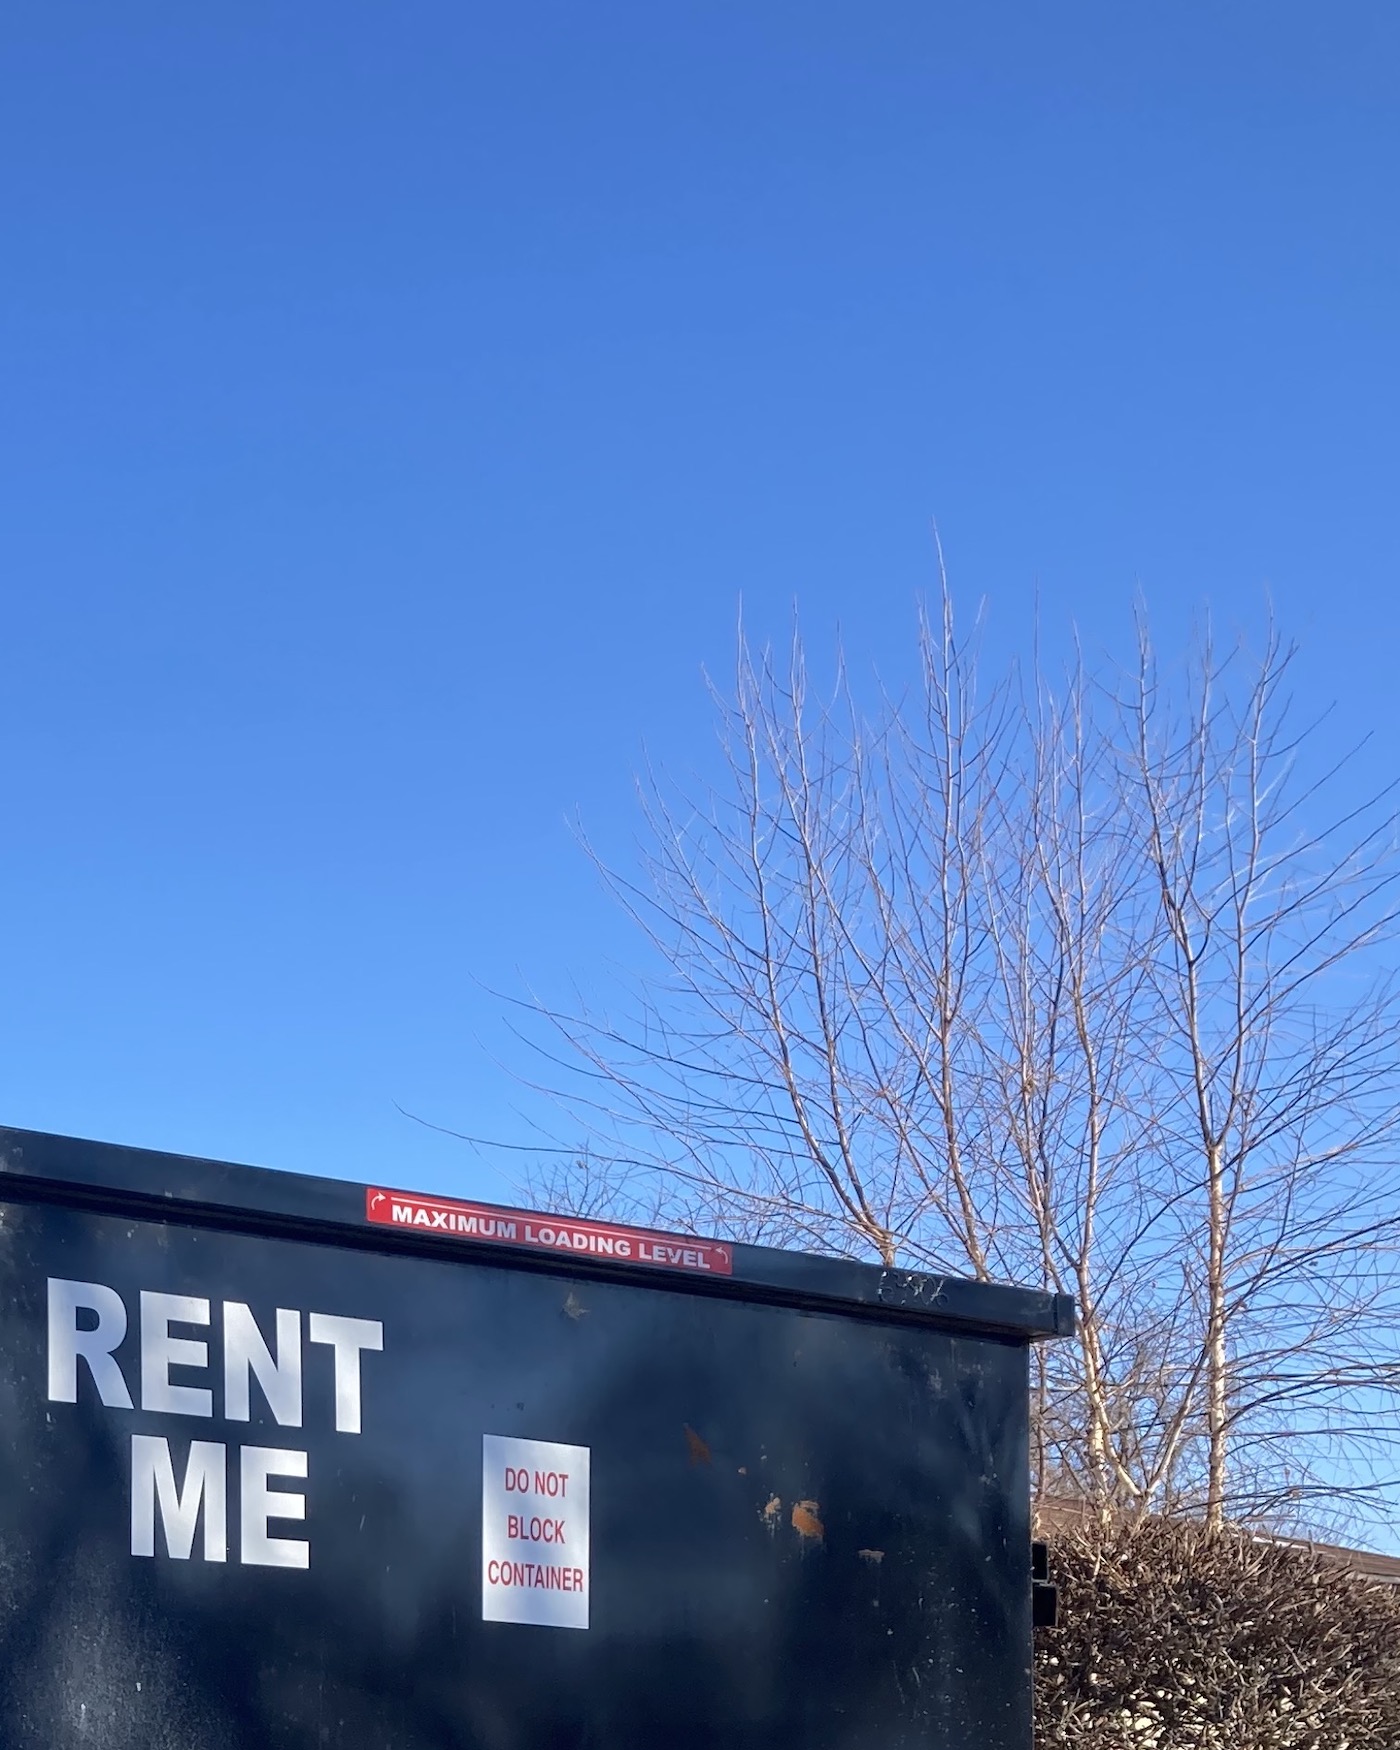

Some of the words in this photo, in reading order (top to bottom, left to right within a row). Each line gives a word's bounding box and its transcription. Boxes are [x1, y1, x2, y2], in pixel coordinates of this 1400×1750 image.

[392, 1204, 517, 1240] MAXIMUM
[525, 1224, 632, 1257] LOADING
[639, 1241, 711, 1270] LEVEL
[47, 1277, 384, 1434] RENT
[130, 1434, 310, 1569] ME
[504, 1467, 530, 1495] DO
[534, 1471, 569, 1499] NOT
[507, 1514, 566, 1545] BLOCK
[487, 1559, 584, 1593] CONTAINER
